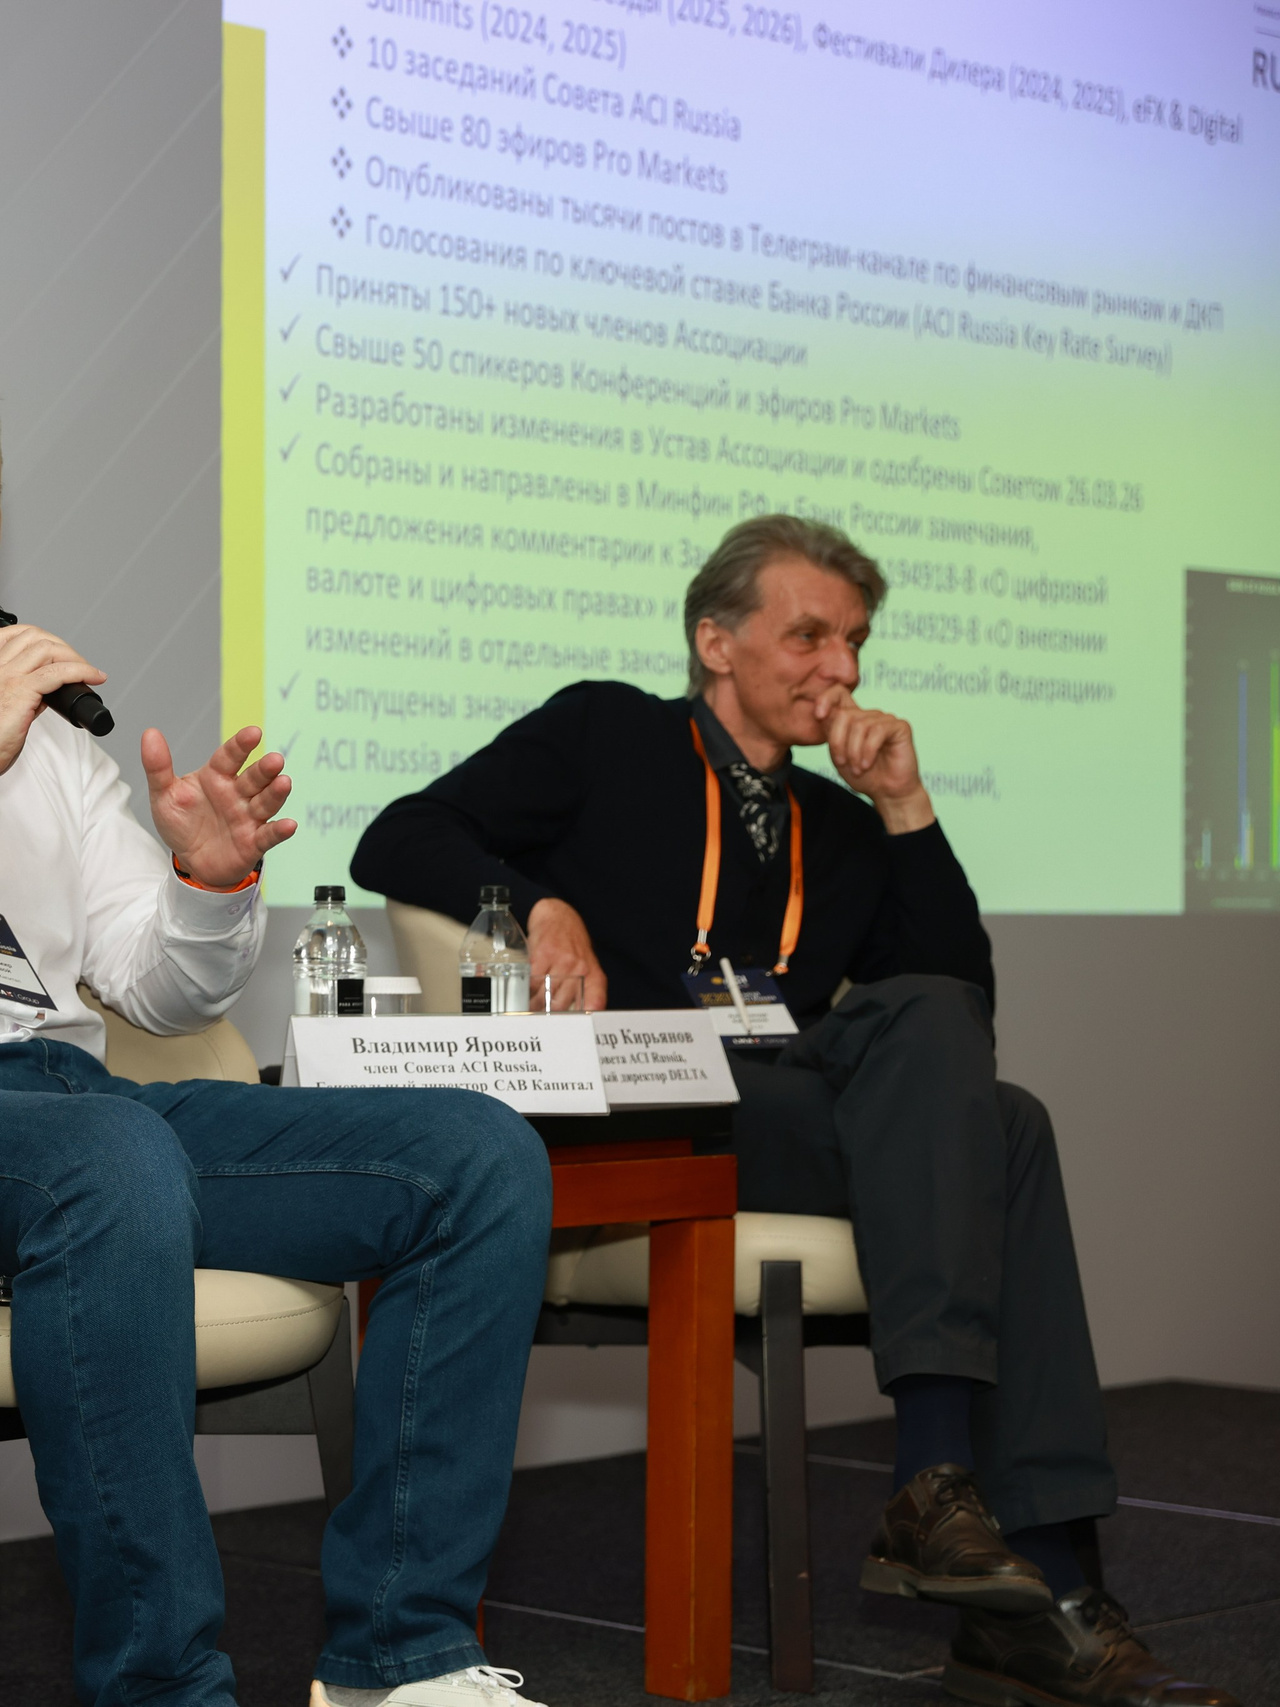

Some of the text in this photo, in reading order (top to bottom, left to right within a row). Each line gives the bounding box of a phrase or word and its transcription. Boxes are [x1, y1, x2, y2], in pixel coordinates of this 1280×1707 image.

[481, 0, 554, 55] (2024,
[561, 18, 626, 71] 2025)
[367, 36, 397, 71] 10
[404, 46, 536, 99] заседаний
[543, 73, 624, 119] Совета
[674, 99, 742, 142] Russia
[366, 96, 729, 195] Свыше 80 эфиров Pro Markets
[1188, 104, 1244, 146] Digital
[366, 155, 553, 219] Опубликованы
[559, 194, 643, 235] тысячи
[649, 213, 724, 249] постов
[730, 231, 743, 251] в
[366, 214, 527, 269] Голосования
[534, 247, 564, 277] по
[570, 253, 685, 296] ключевой
[691, 271, 763, 307] ставке
[768, 279, 831, 319] Банка
[837, 293, 910, 331] России
[958, 311, 1018, 347] Russia
[316, 264, 808, 368] Приняты 150+ новых членов Ассоциации
[316, 323, 405, 369] Свыше
[413, 337, 443, 372] 50
[449, 350, 563, 397] спикеров
[737, 390, 750, 410] и
[755, 386, 835, 426] эфиров
[840, 396, 875, 428] Pro
[880, 402, 961, 441] Markets
[315, 382, 484, 436] Разработаны
[491, 413, 622, 449] изменения
[630, 432, 643, 453] в
[648, 425, 711, 463] Устав
[717, 435, 847, 477] Ассоциации
[852, 458, 865, 478] и
[870, 455, 973, 494] одобрены
[979, 465, 1061, 503] Советом
[315, 442, 431, 488] Собраны
[439, 463, 453, 487] и
[461, 464, 610, 509] направлены
[617, 486, 630, 507] в
[636, 478, 732, 518] Минфин
[850, 501, 918, 538] России
[926, 518, 1038, 553] замечания,
[306, 504, 484, 550] предложения
[491, 528, 654, 568] комментарии
[661, 543, 674, 563] к
[1013, 572, 1108, 609] цифровой
[306, 566, 401, 600] валюте
[408, 576, 424, 600] и
[431, 571, 557, 614] цифровых
[562, 588, 655, 622] правах»
[663, 602, 678, 619] и
[306, 625, 452, 661] изменений
[458, 637, 473, 663] в
[478, 638, 611, 674] отдельные
[315, 678, 456, 724] Выпущены
[364, 740, 442, 775] Russia
[351, 1036, 543, 1057] Владимир Яровой
[363, 1063, 398, 1075] член
[403, 1061, 455, 1075] Совета
[493, 1060, 543, 1076] Russia,
[620, 1028, 694, 1049] Кирьянов
[532, 1078, 595, 1092] Капитал
[620, 1072, 668, 1086] директор
[669, 1068, 708, 1082] DELTA
